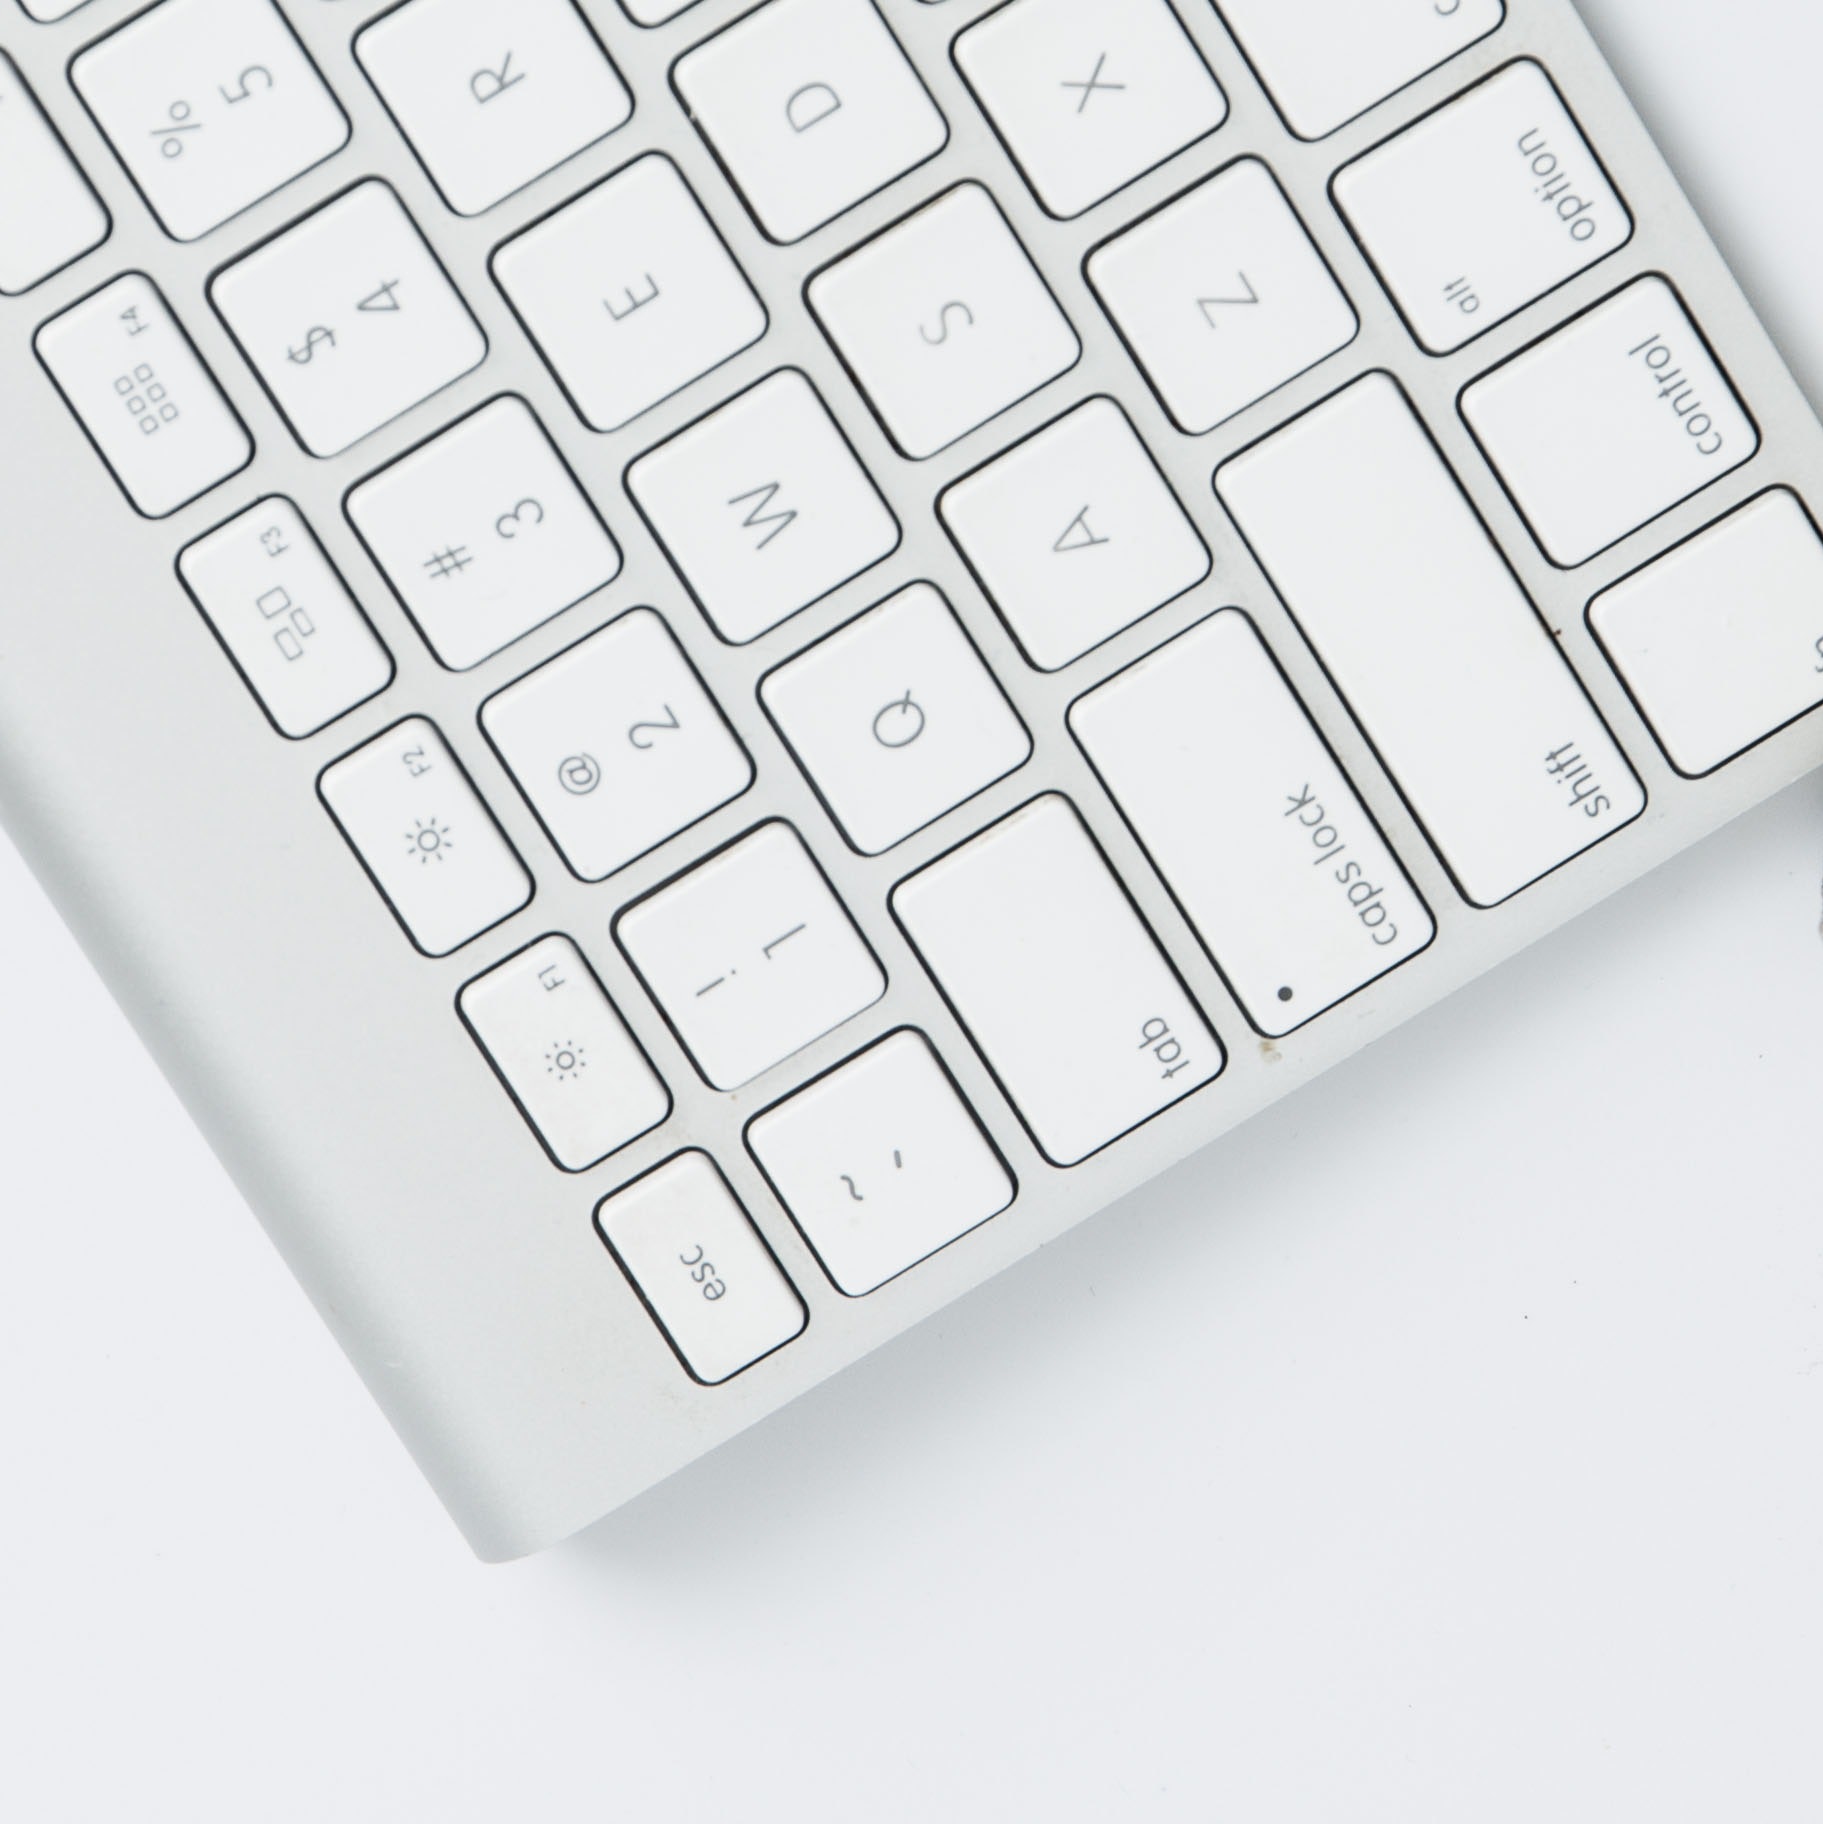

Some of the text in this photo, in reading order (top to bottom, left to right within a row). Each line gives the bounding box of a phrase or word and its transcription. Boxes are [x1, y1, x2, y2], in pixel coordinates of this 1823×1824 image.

[219, 64, 274, 105] 5
[469, 51, 526, 105] R
[1061, 52, 1126, 114] X
[149, 99, 203, 160] %
[785, 81, 843, 134] D
[1516, 127, 1597, 242] option
[356, 279, 401, 313] 4
[603, 273, 660, 322] E
[1196, 271, 1260, 329] Z
[1442, 276, 1481, 315] alt
[119, 305, 148, 337] F4
[919, 300, 975, 346] S
[287, 325, 336, 365] $
[1628, 332, 1723, 457] control
[494, 497, 545, 540] 3
[727, 481, 799, 550] W
[1052, 504, 1110, 553] A
[260, 526, 289, 558] F3
[423, 546, 473, 578] #
[627, 704, 681, 750] 2
[871, 689, 926, 749] Q
[402, 746, 431, 778] F2
[557, 753, 602, 796] @
[1544, 741, 1613, 819] shift
[1285, 782, 1399, 946] caps lock
[762, 923, 807, 960] 1
[537, 964, 565, 992] F1
[695, 969, 737, 998] !
[1137, 1016, 1190, 1080] tab
[679, 1244, 727, 1302] esc
